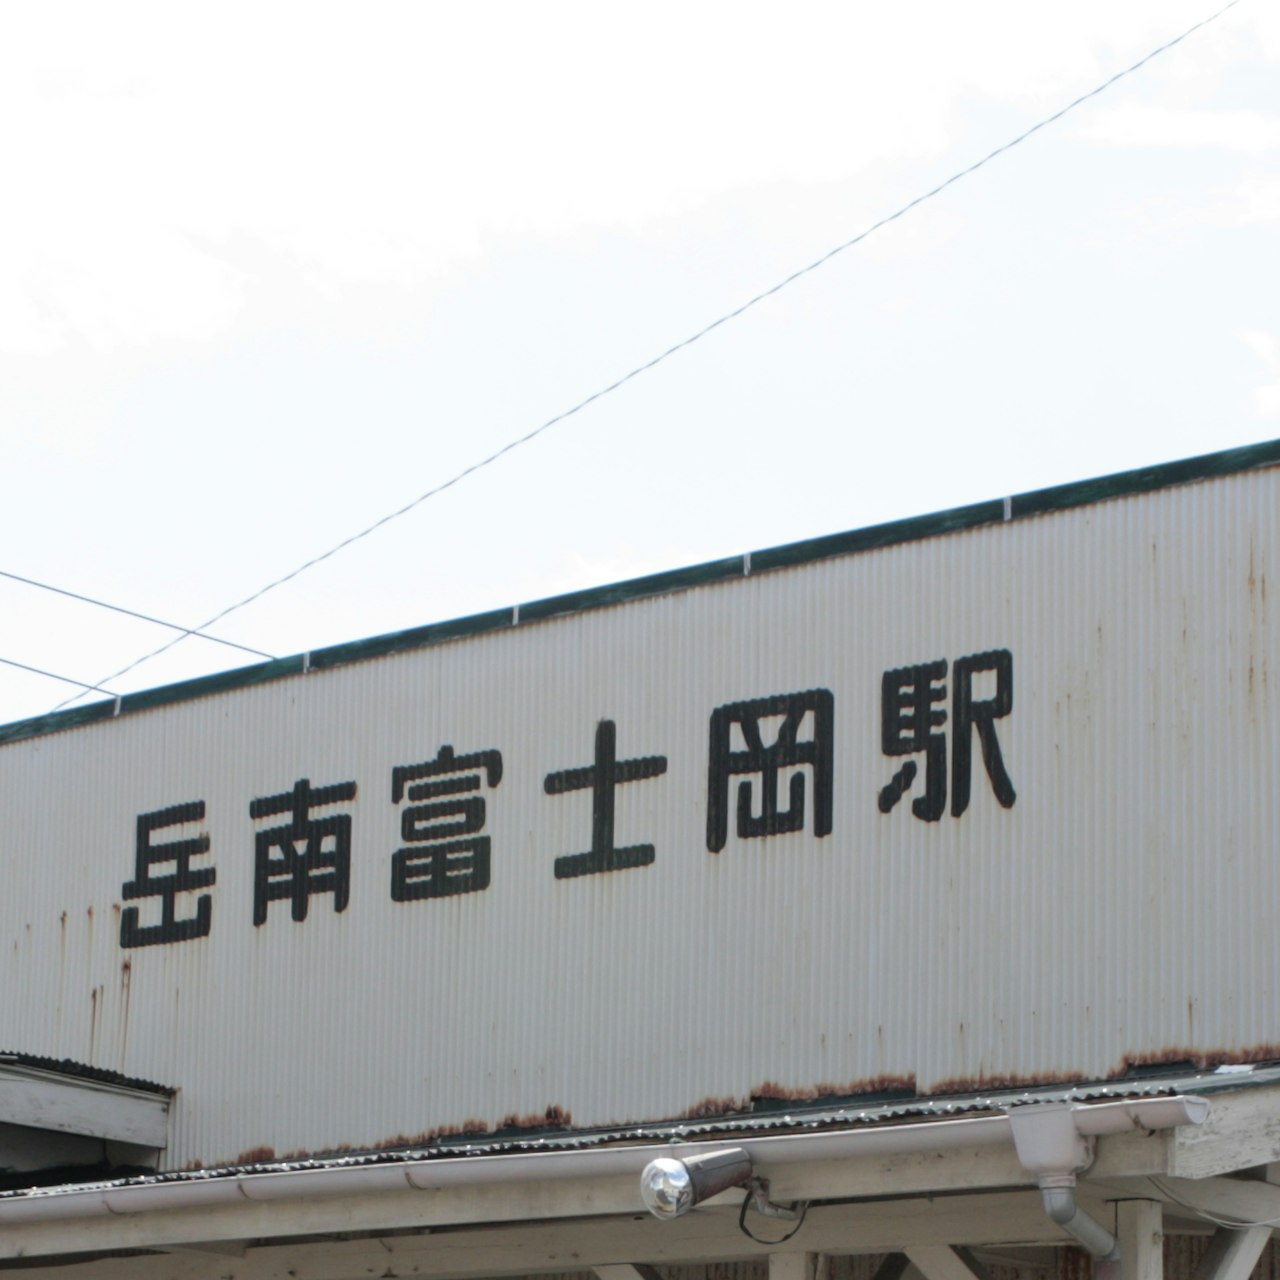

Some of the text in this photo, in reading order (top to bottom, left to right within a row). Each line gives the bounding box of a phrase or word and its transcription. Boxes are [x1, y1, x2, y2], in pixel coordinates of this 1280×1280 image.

[121, 648, 1016, 949] 岳南富士岡駅
